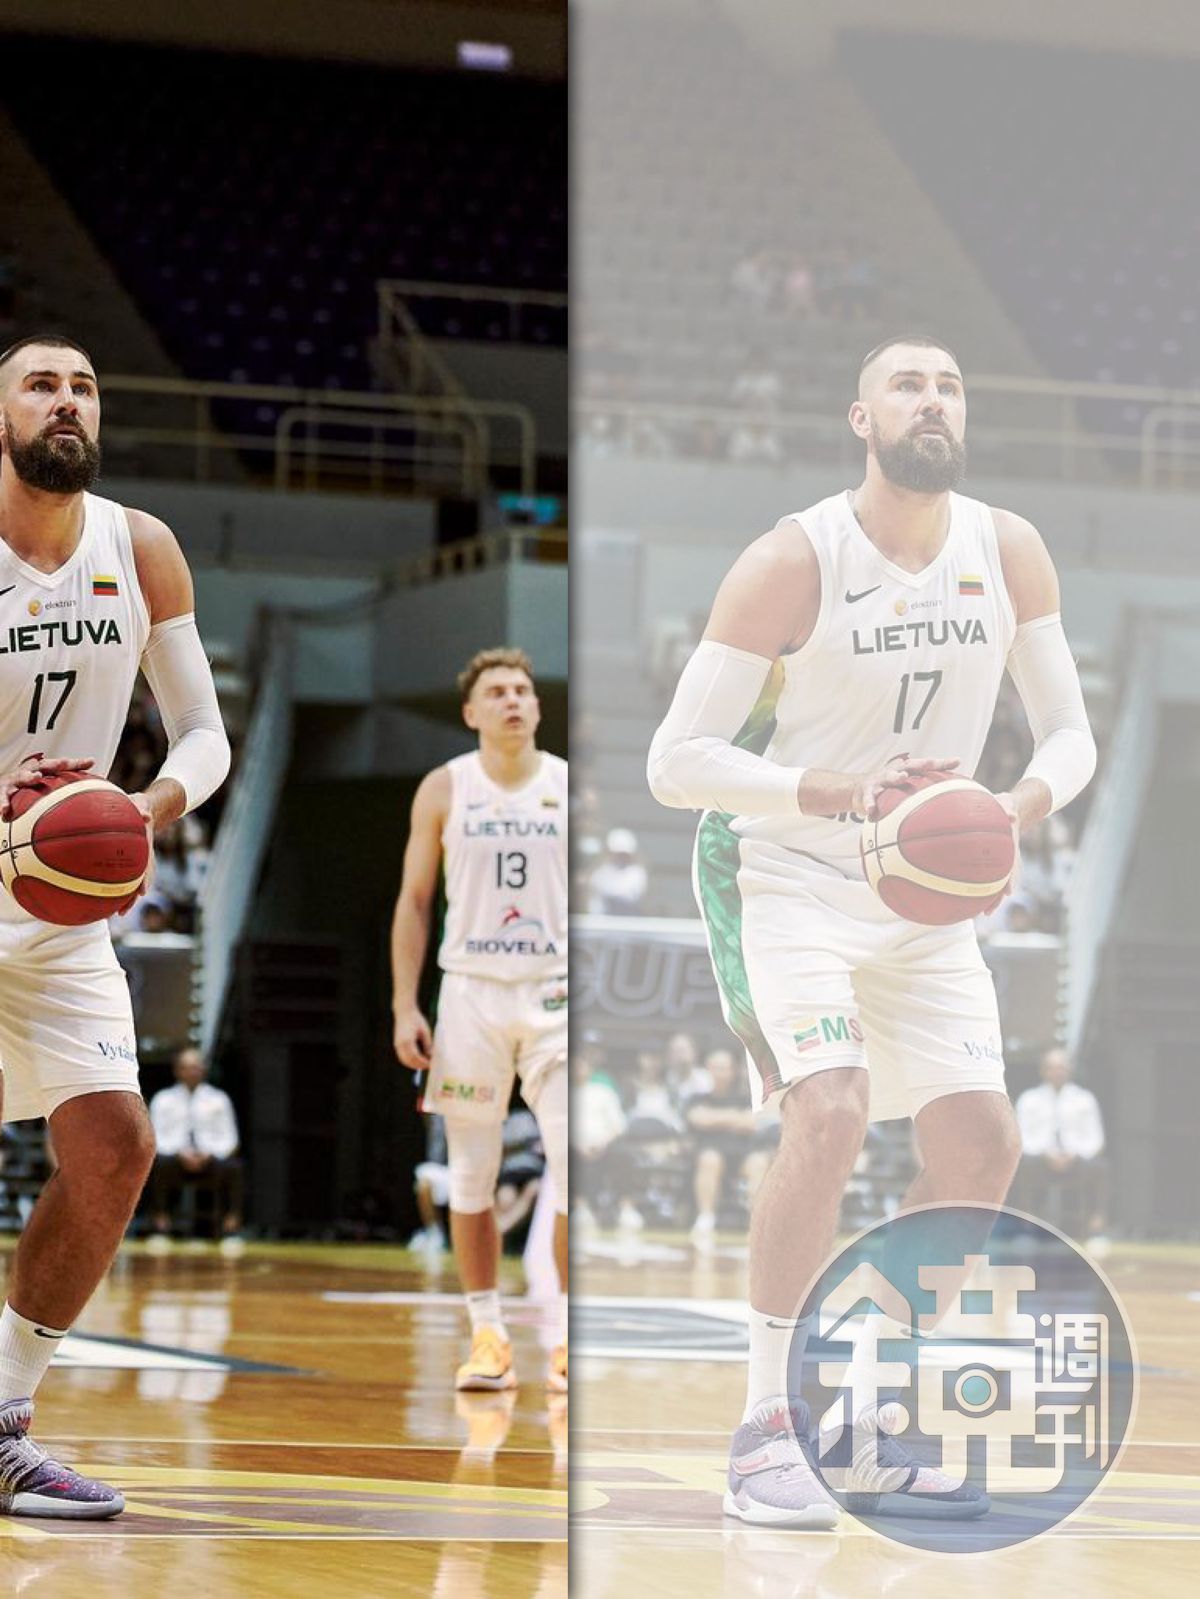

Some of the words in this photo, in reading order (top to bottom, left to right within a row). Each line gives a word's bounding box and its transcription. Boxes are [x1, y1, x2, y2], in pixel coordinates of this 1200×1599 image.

[853, 619, 988, 655] LIETUVA
[27, 670, 77, 734] 17
[893, 670, 943, 734] 17
[464, 821, 558, 836] LIETUVA
[496, 851, 527, 889] 13
